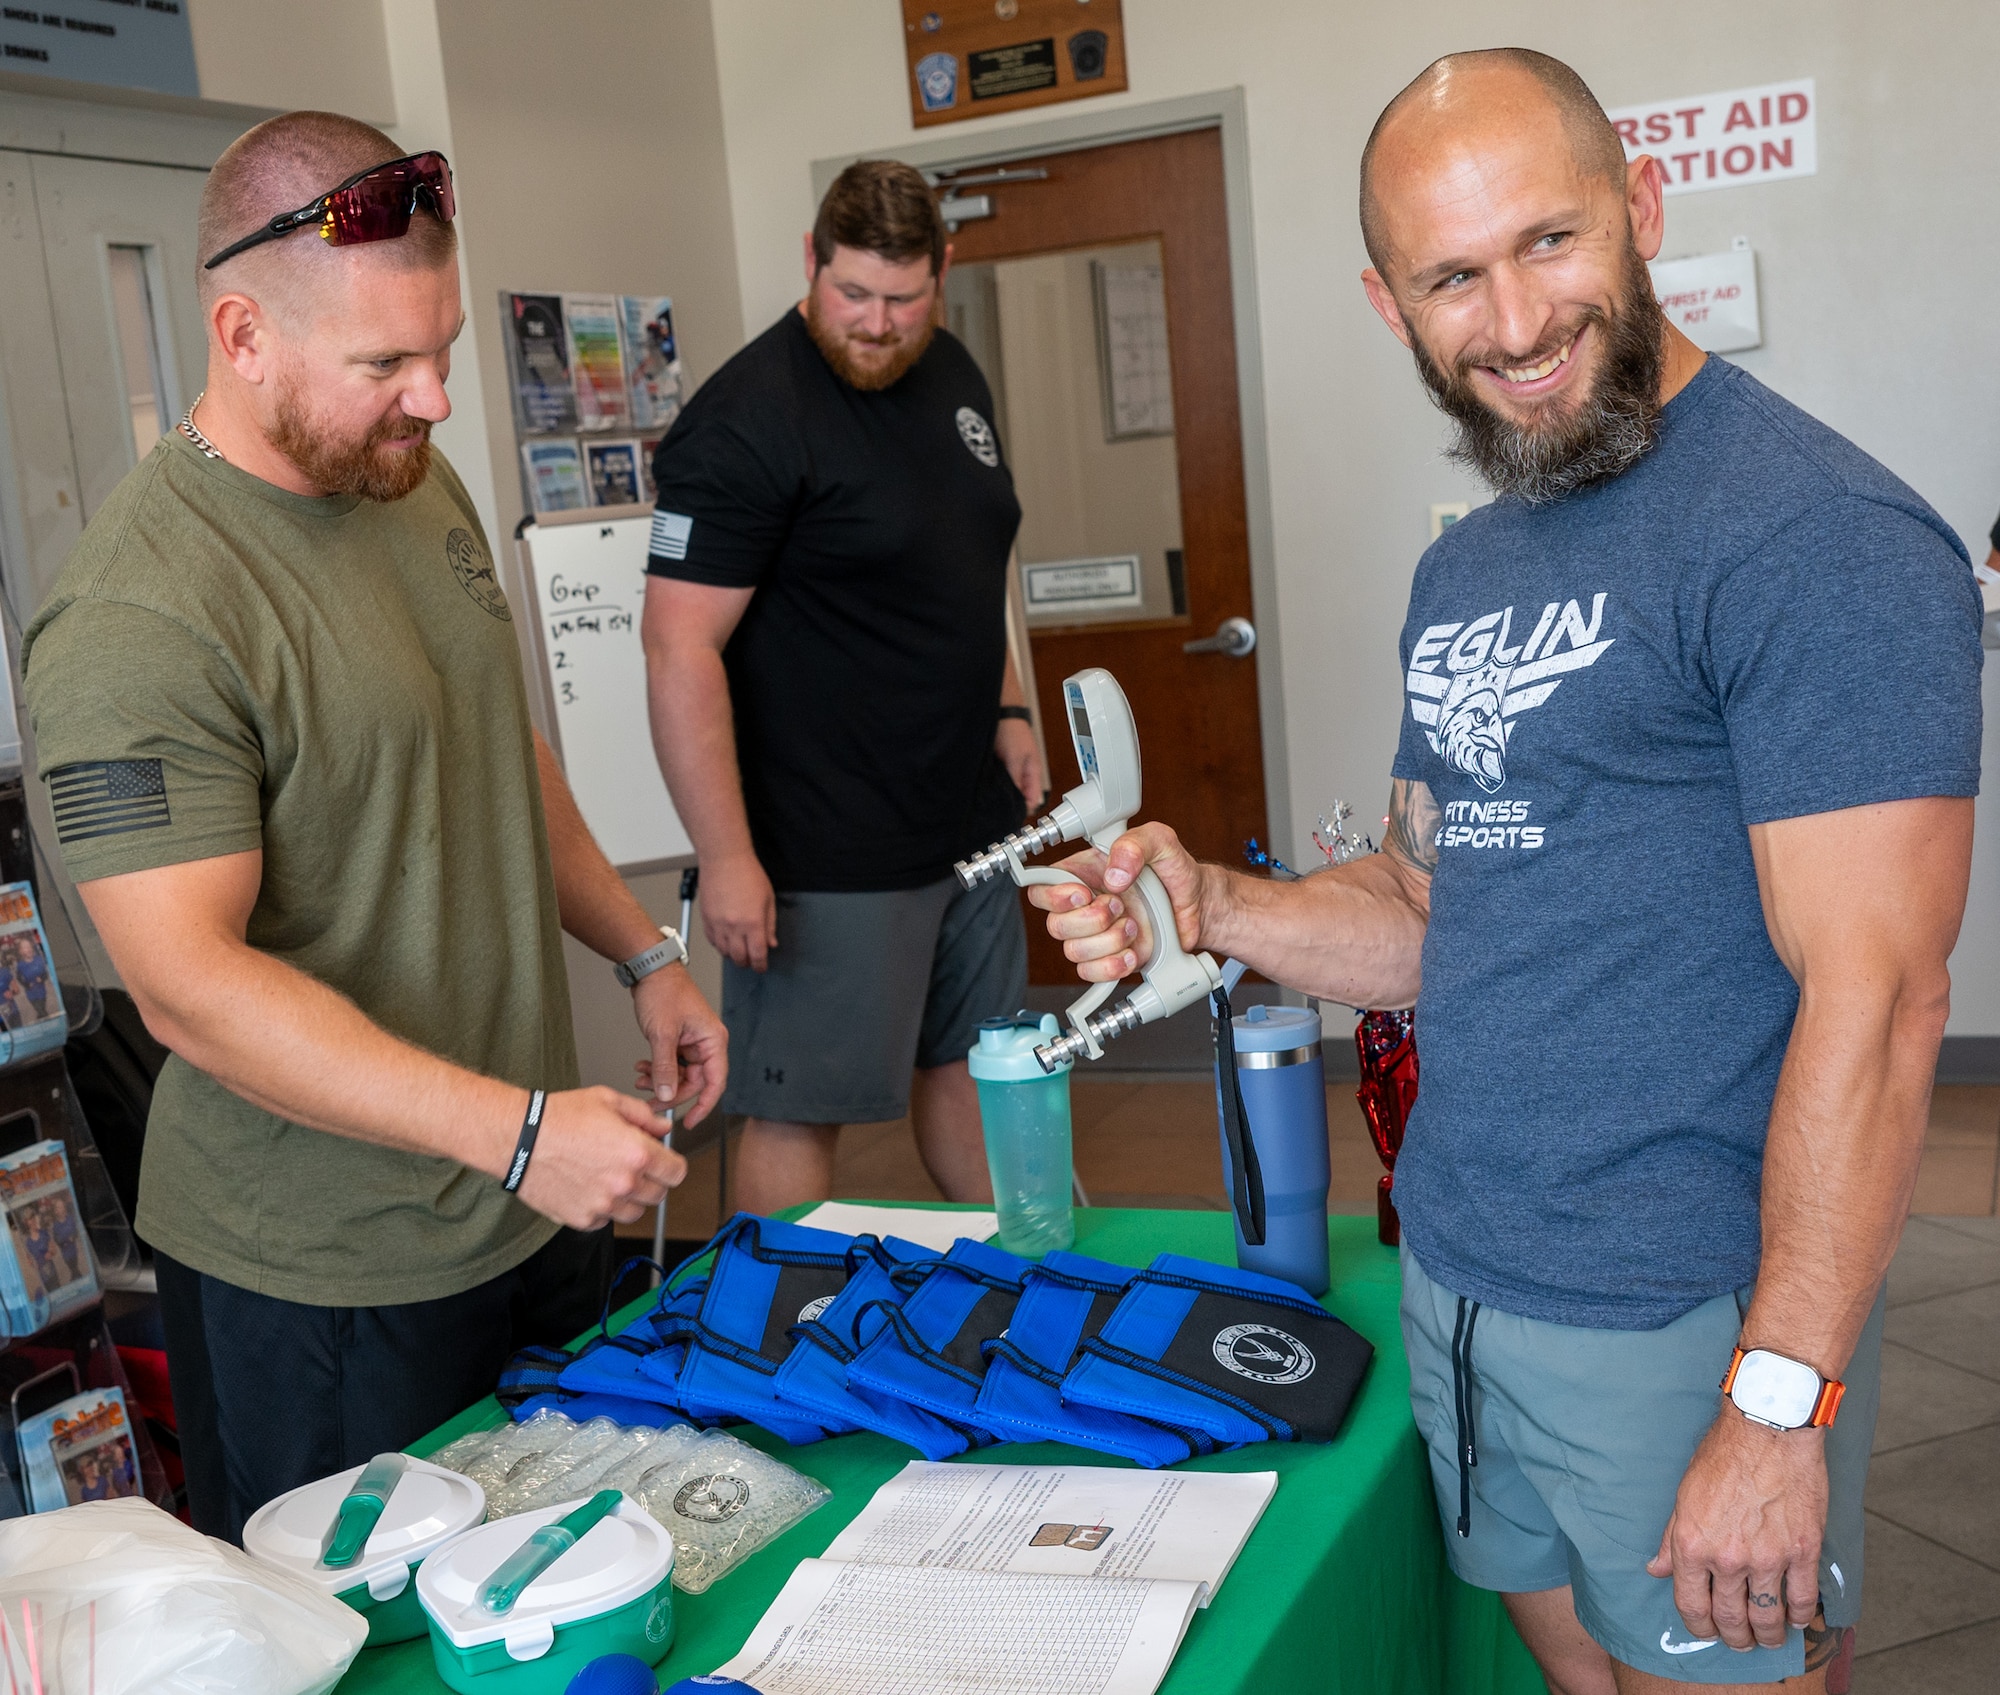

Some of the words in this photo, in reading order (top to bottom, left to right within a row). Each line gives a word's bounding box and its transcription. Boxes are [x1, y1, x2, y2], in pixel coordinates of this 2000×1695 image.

[1611, 107, 1705, 147] RST
[1723, 92, 1809, 133] AID
[1660, 138, 1794, 185] TION
[1661, 289, 1708, 308] FIRST
[1713, 285, 1741, 300] AID
[1683, 309, 1711, 324] KIT
[550, 573, 600, 603] Grip
[1409, 592, 1608, 673] EGLIN
[1446, 800, 1531, 824] FITNESS
[1443, 826, 1545, 848] SPORTS
